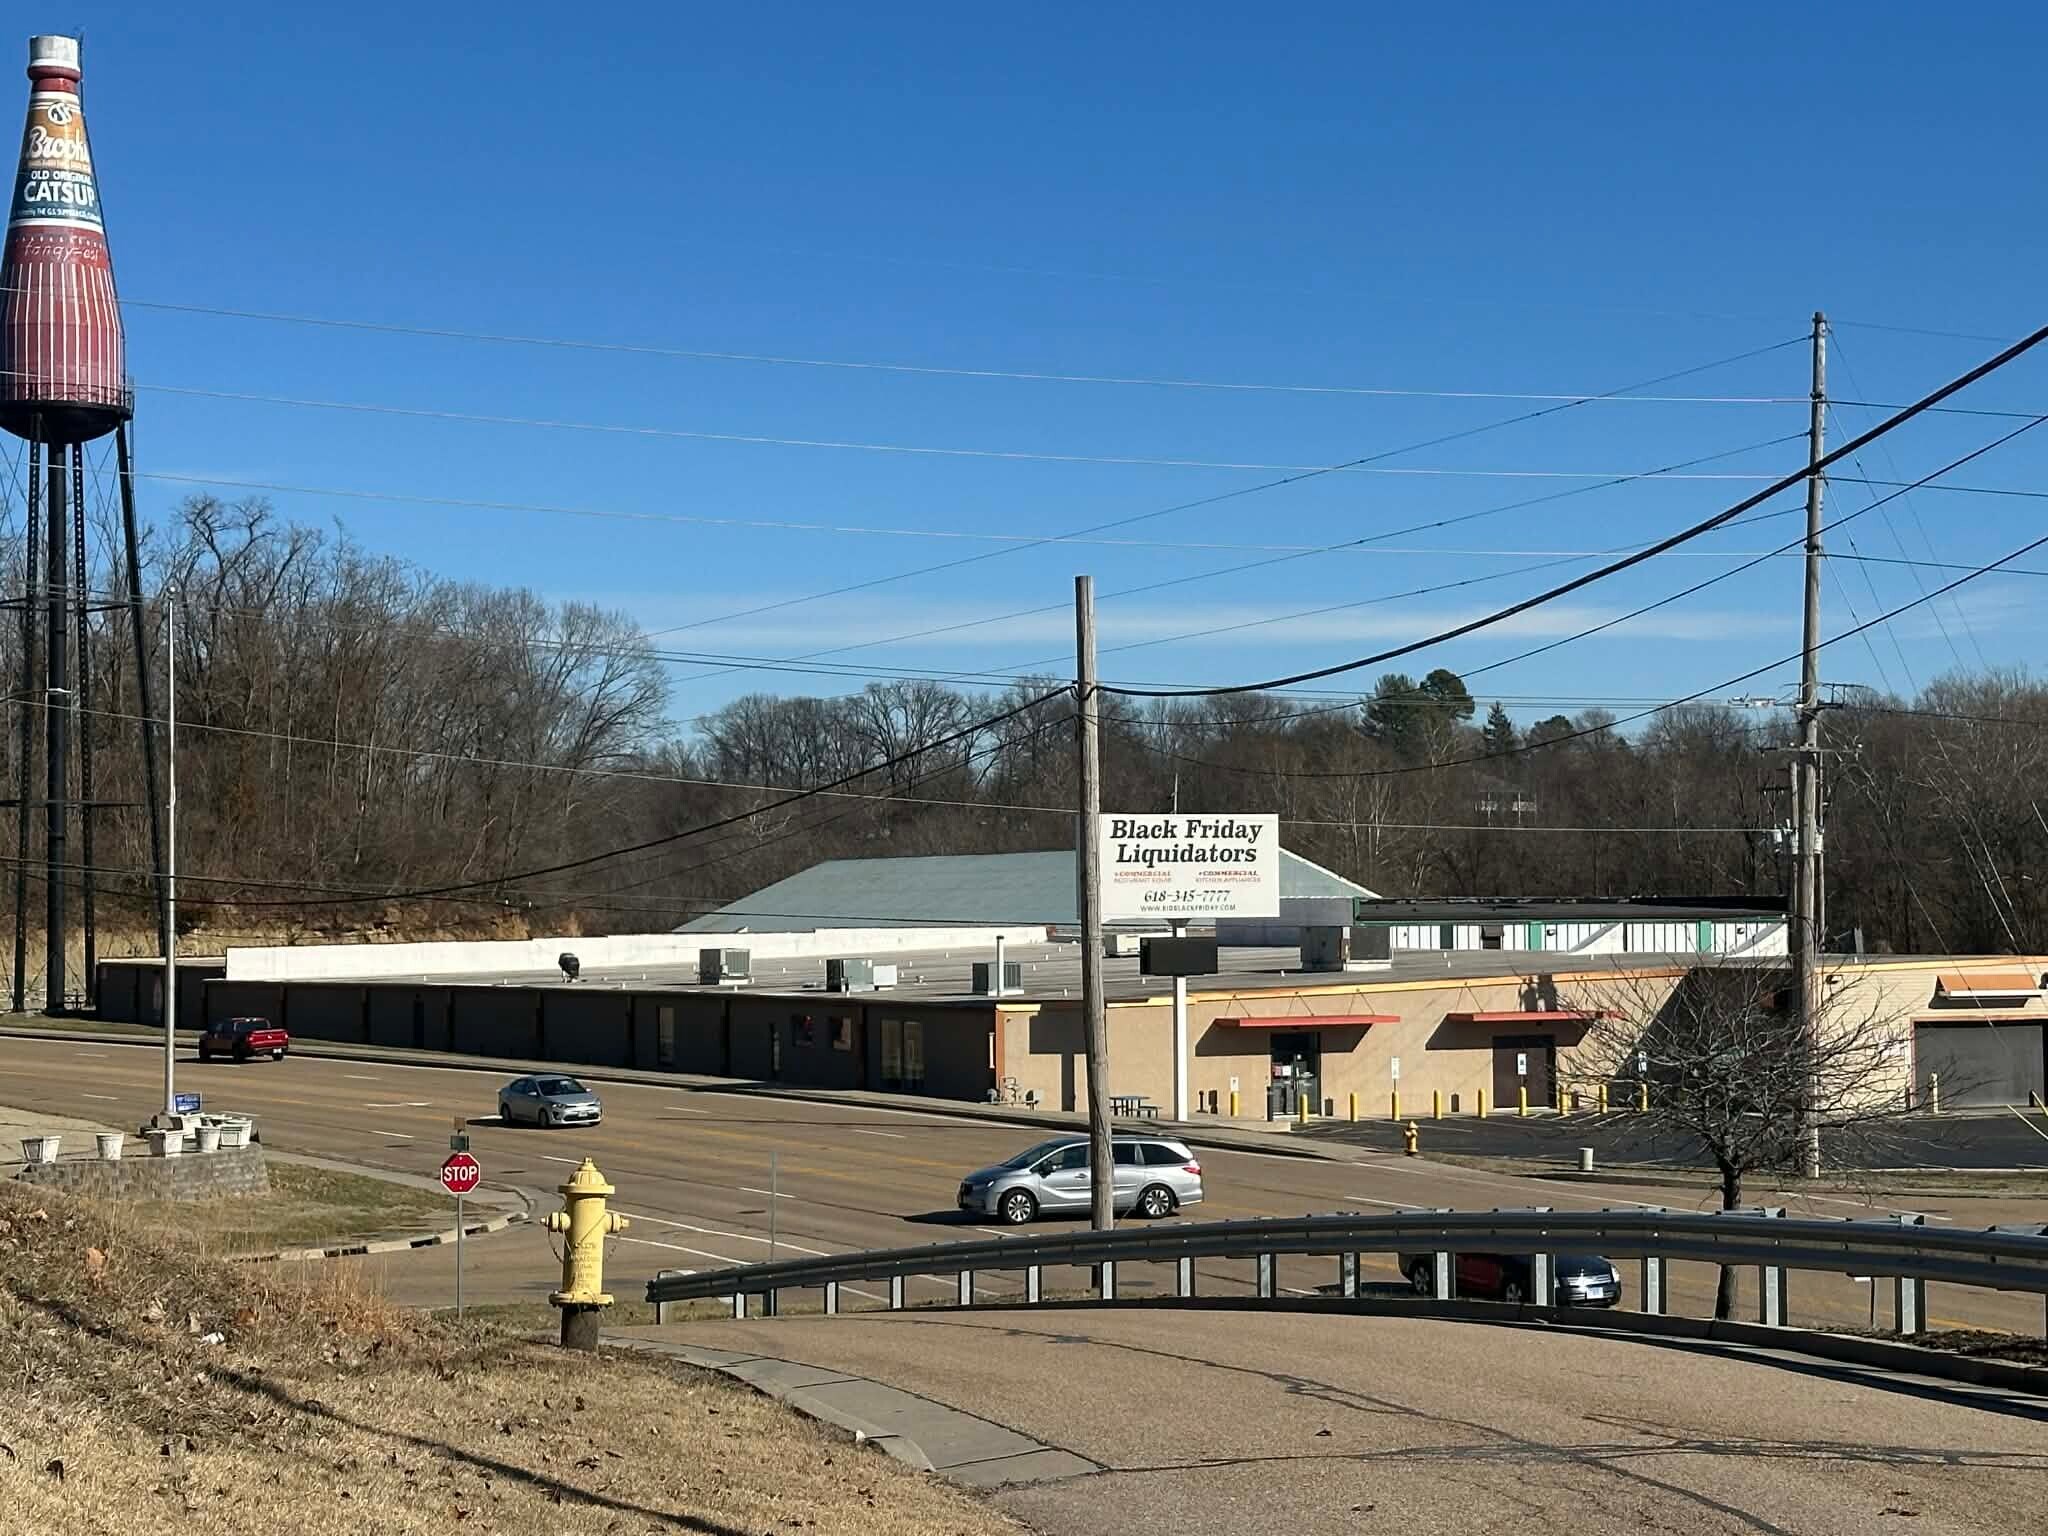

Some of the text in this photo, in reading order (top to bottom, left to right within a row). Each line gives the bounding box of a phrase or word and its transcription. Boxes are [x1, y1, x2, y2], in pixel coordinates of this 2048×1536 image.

[31, 170, 50, 180] OLD
[23, 181, 95, 207] CATSUP
[1110, 819, 1263, 844] Black Friday
[1116, 843, 1257, 868] Liquidators
[1144, 889, 1232, 903] 618-345-7777
[443, 1165, 478, 1182] STOP
